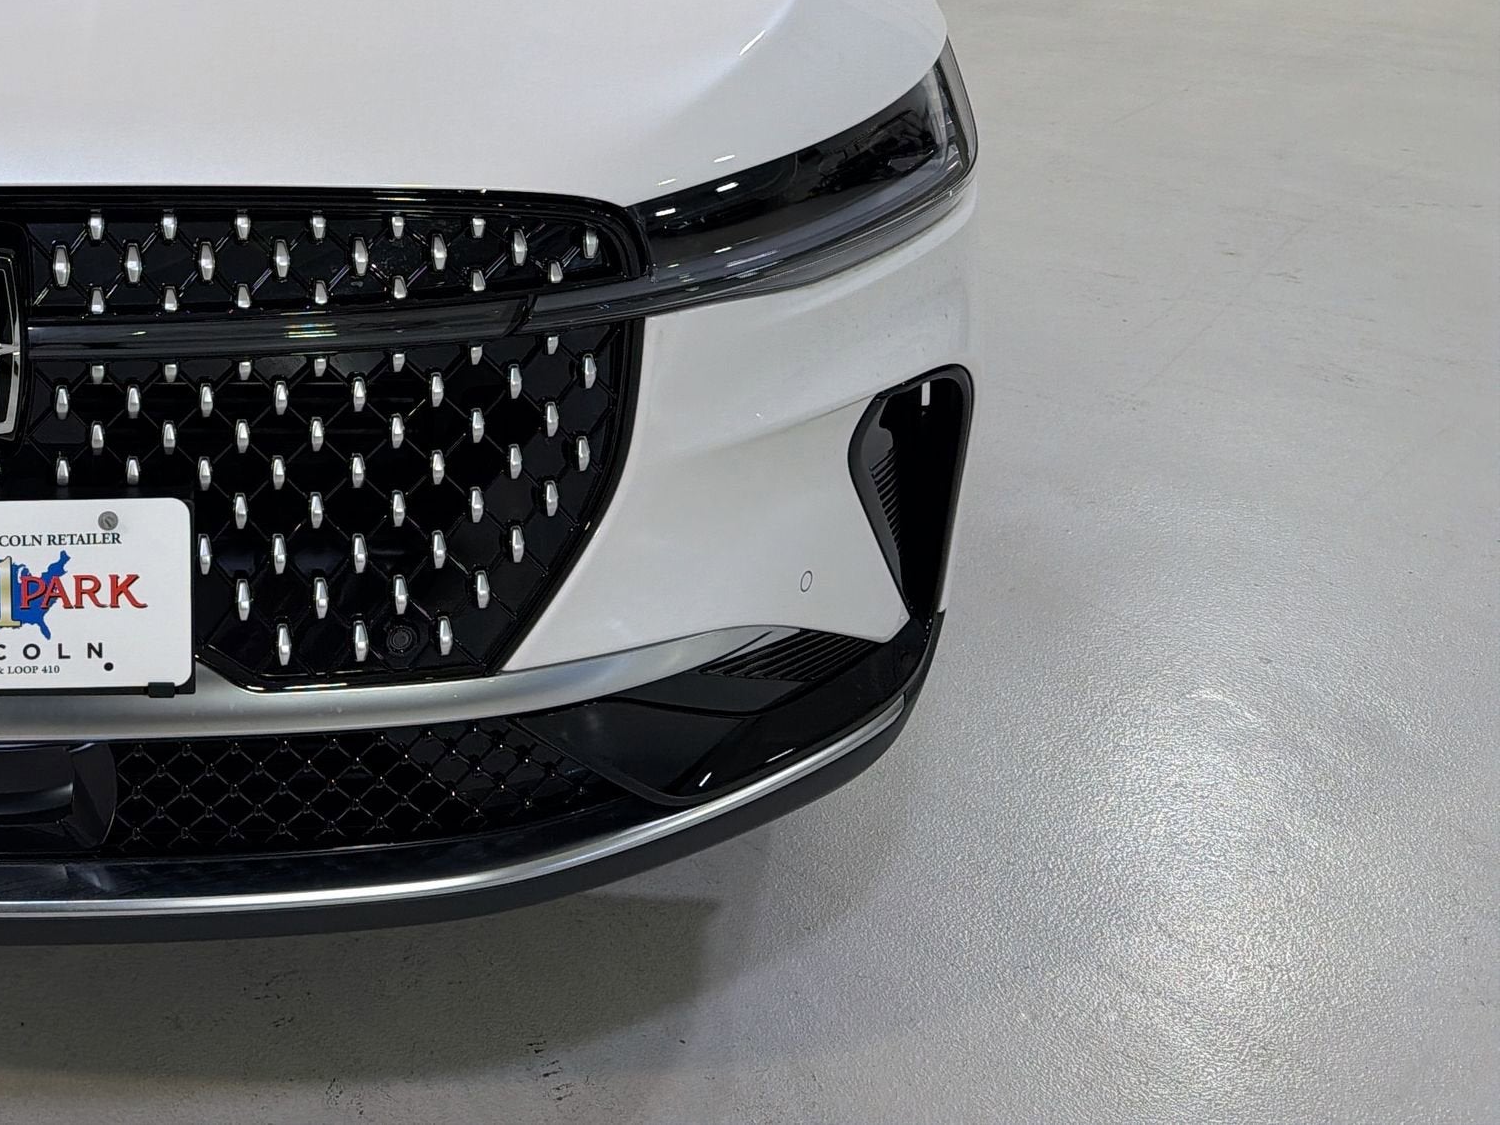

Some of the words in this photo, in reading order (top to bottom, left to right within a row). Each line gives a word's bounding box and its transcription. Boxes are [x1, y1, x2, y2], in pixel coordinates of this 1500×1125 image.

[47, 532, 122, 546] RETAILER
[19, 574, 148, 610] PARK
[7, 665, 38, 675] LOOP
[41, 665, 61, 674] 410
